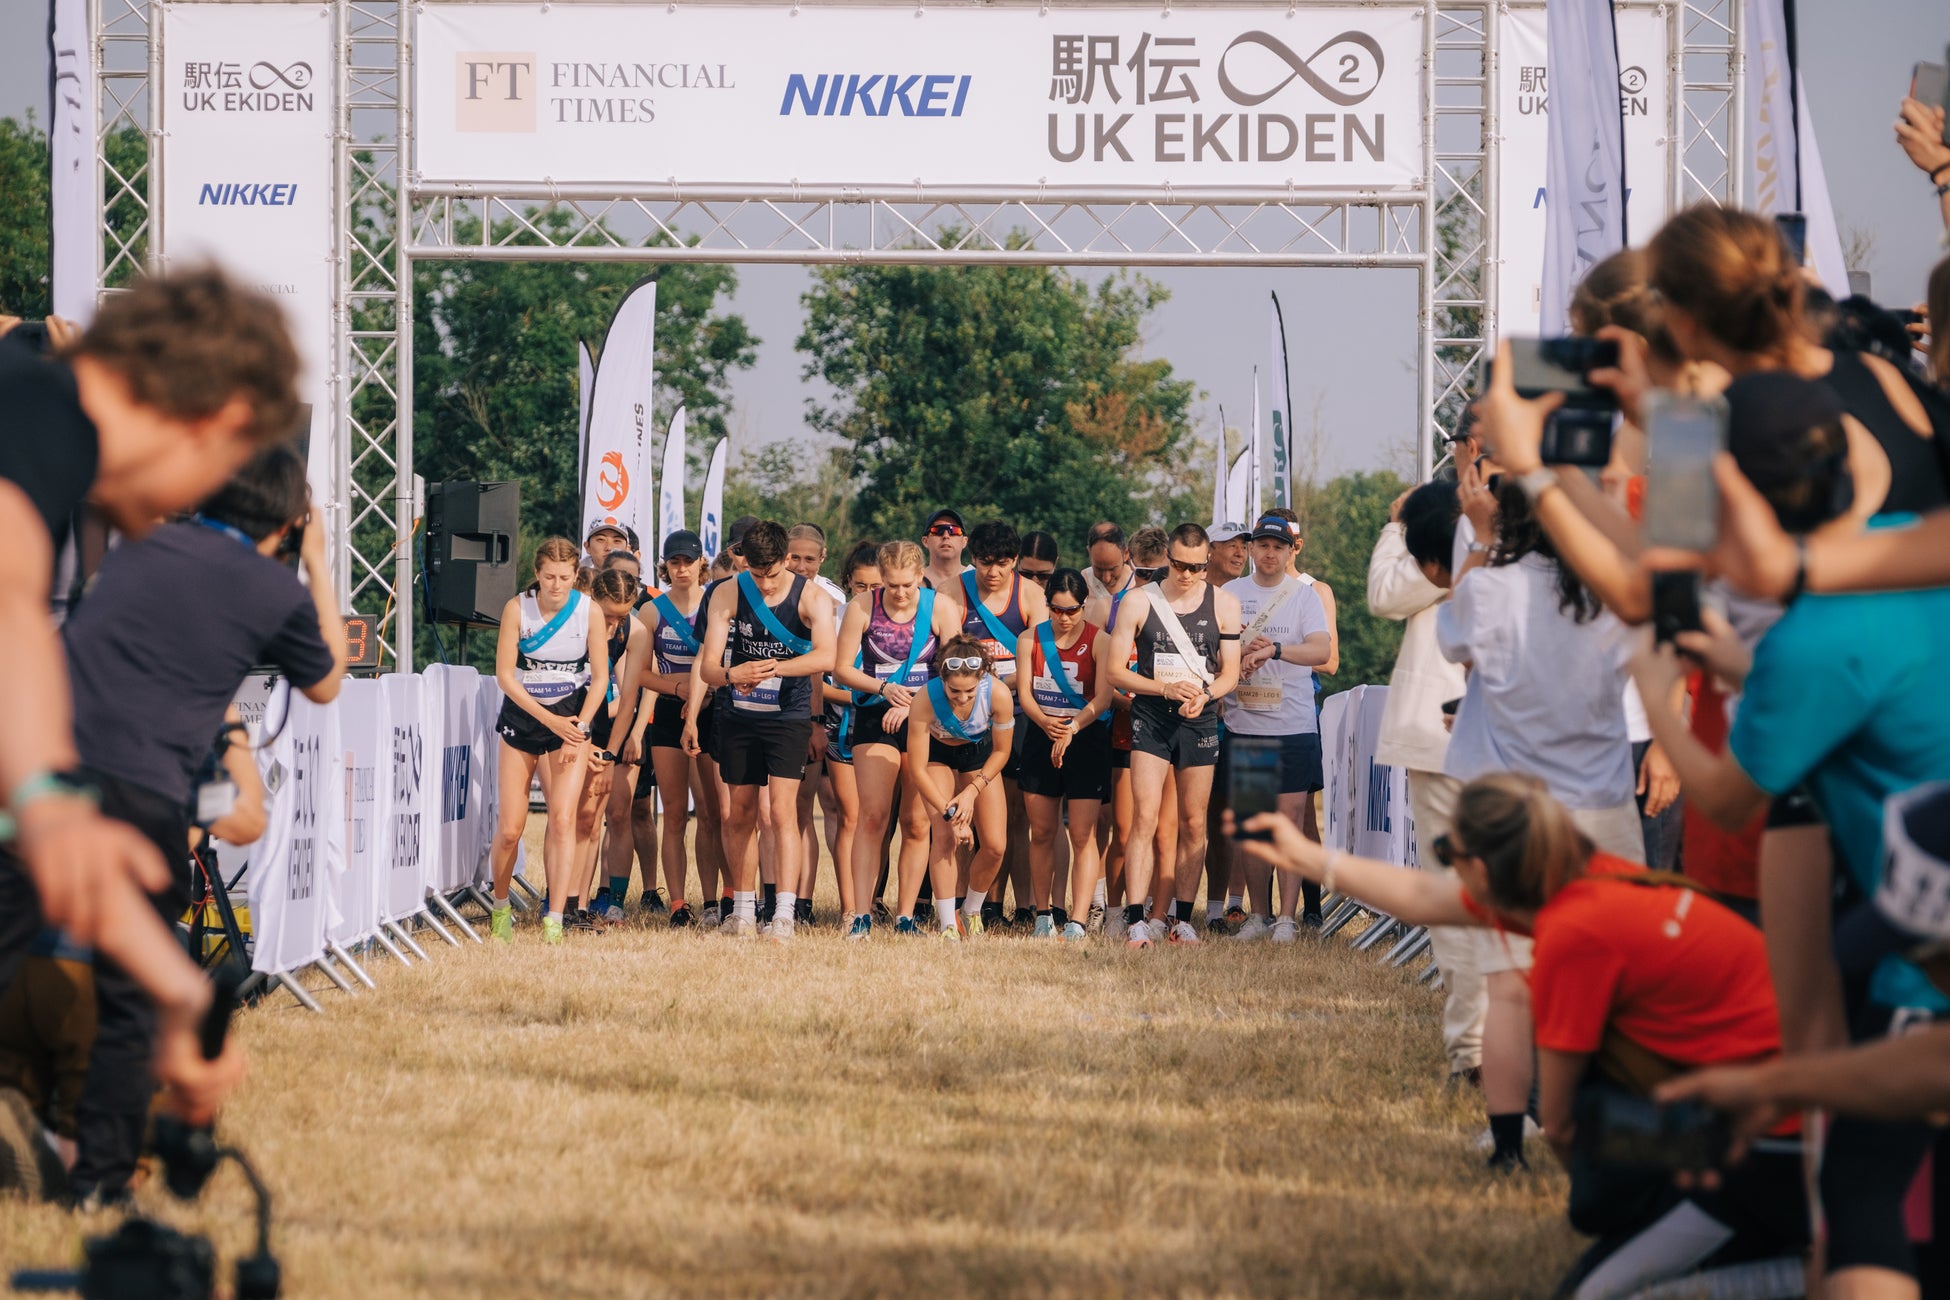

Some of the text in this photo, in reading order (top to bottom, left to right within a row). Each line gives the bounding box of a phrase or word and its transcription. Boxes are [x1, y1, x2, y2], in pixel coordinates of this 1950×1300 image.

[183, 61, 242, 90] 駅伝
[465, 62, 531, 100] FT
[551, 63, 736, 89] FINANCIAL
[1049, 32, 1201, 105] 駅伝
[1519, 66, 1547, 93] 駅
[183, 92, 313, 112] UK EKIDEN
[780, 74, 972, 117] NIKKEI
[1518, 96, 1548, 116] UK
[551, 98, 656, 123] TIMES
[1048, 113, 1384, 163] UK EKIDEN
[199, 183, 297, 206] NIKKEI
[1038, 694, 1054, 702] TEAM
